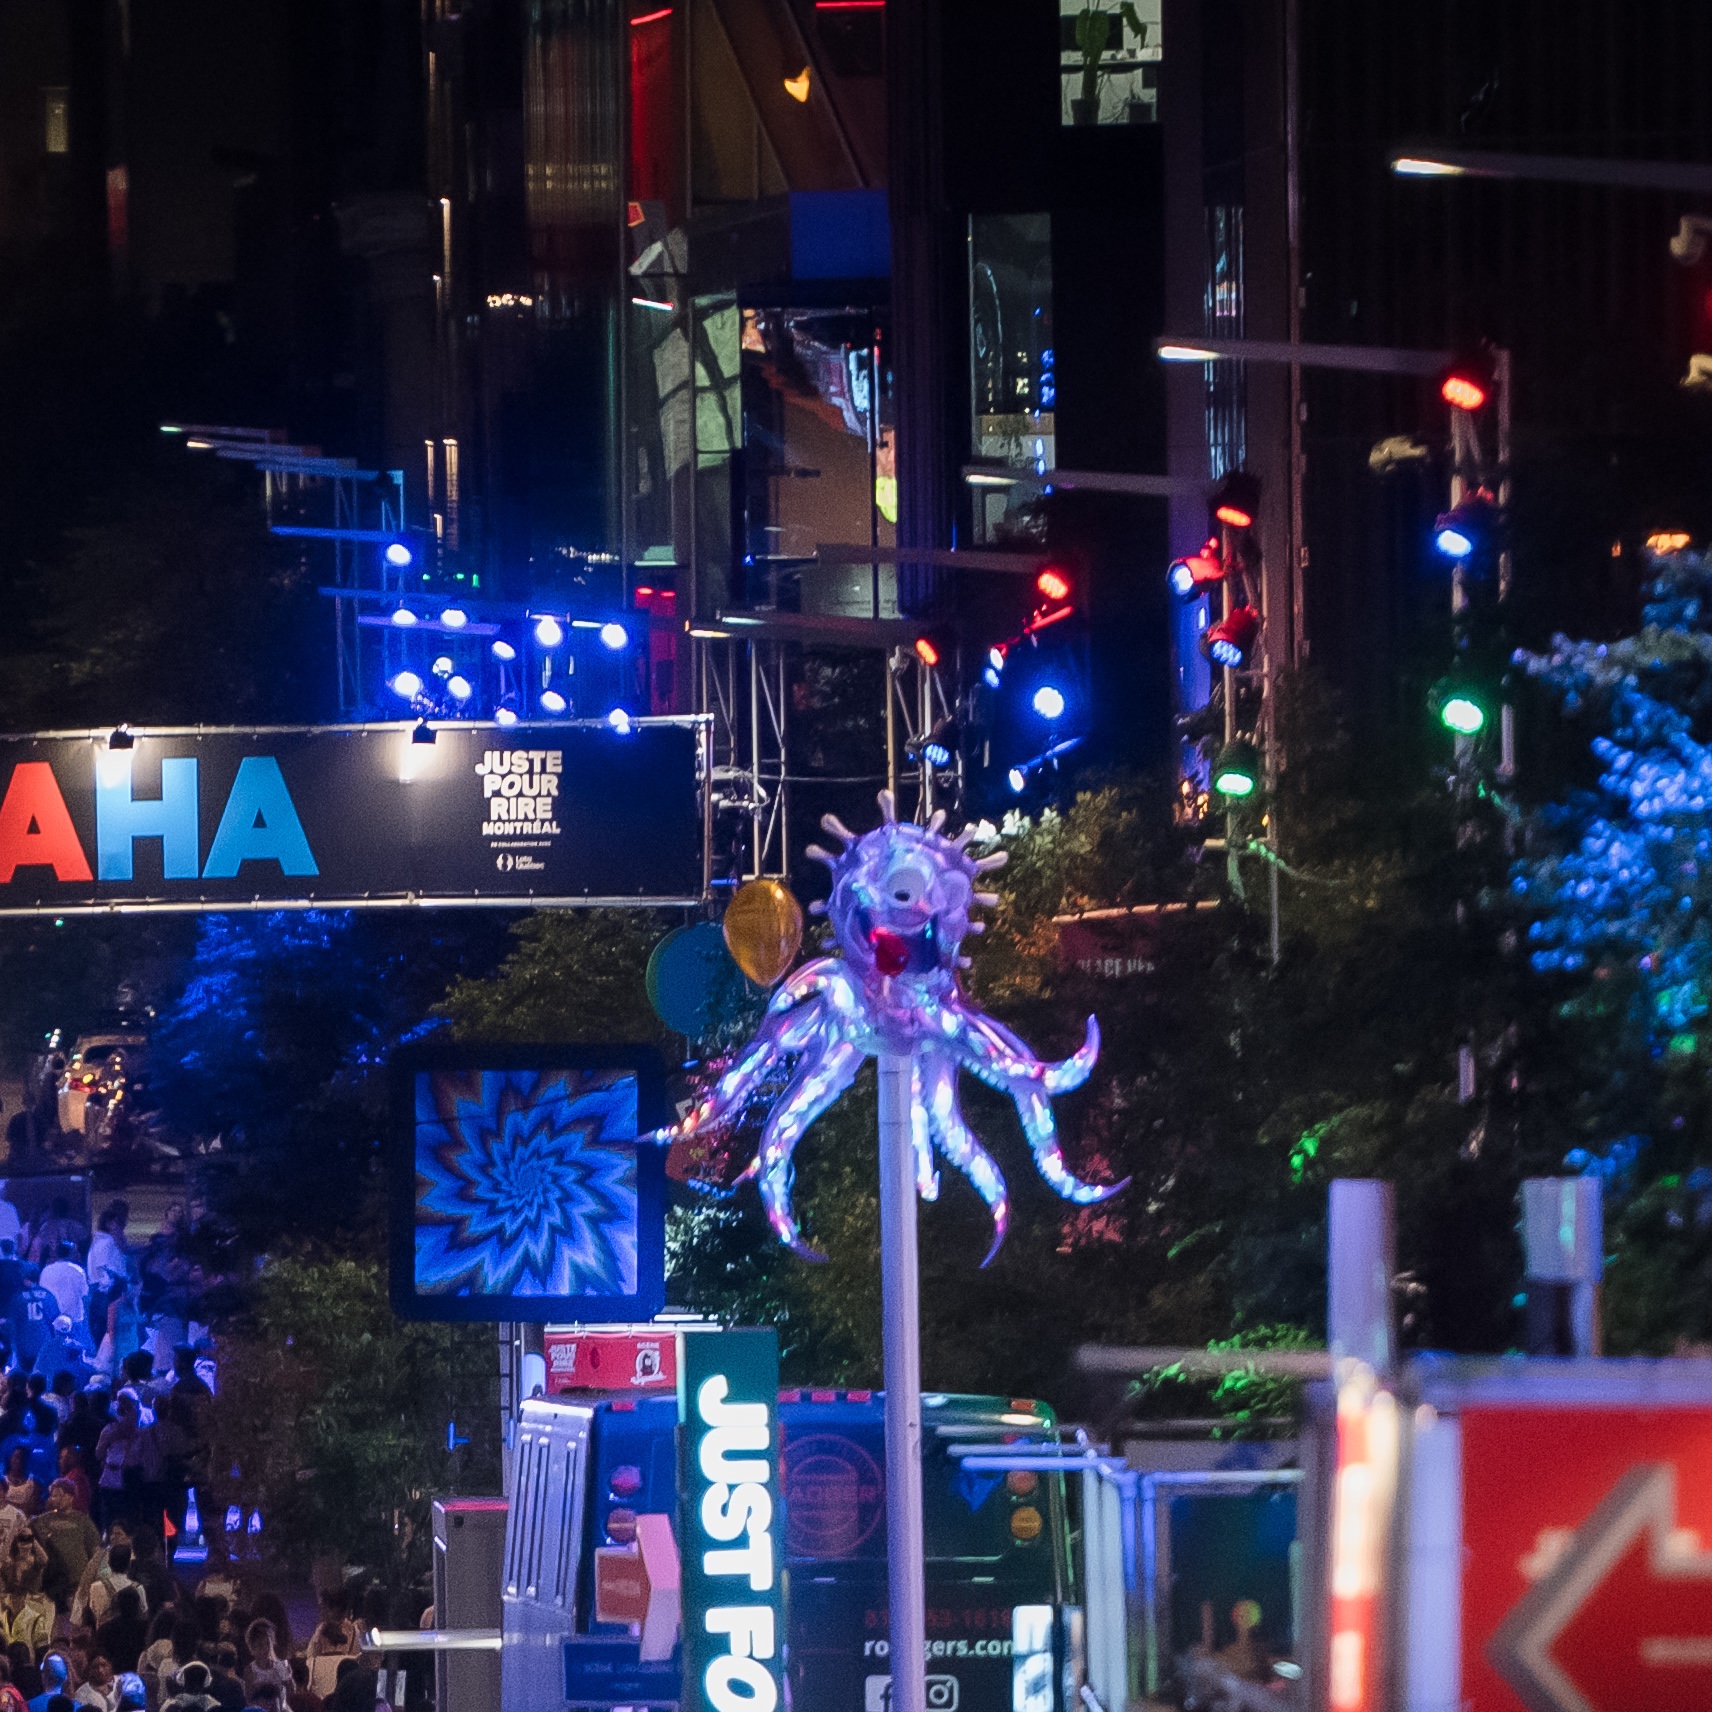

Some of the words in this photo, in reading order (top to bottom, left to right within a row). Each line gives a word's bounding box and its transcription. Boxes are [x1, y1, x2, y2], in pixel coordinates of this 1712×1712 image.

[474, 749, 563, 775] JUSTE
[483, 773, 559, 798] POUR
[490, 796, 553, 820] RIRE
[482, 819, 561, 836] MONTRÉAL
[698, 1374, 775, 1591] JUST
